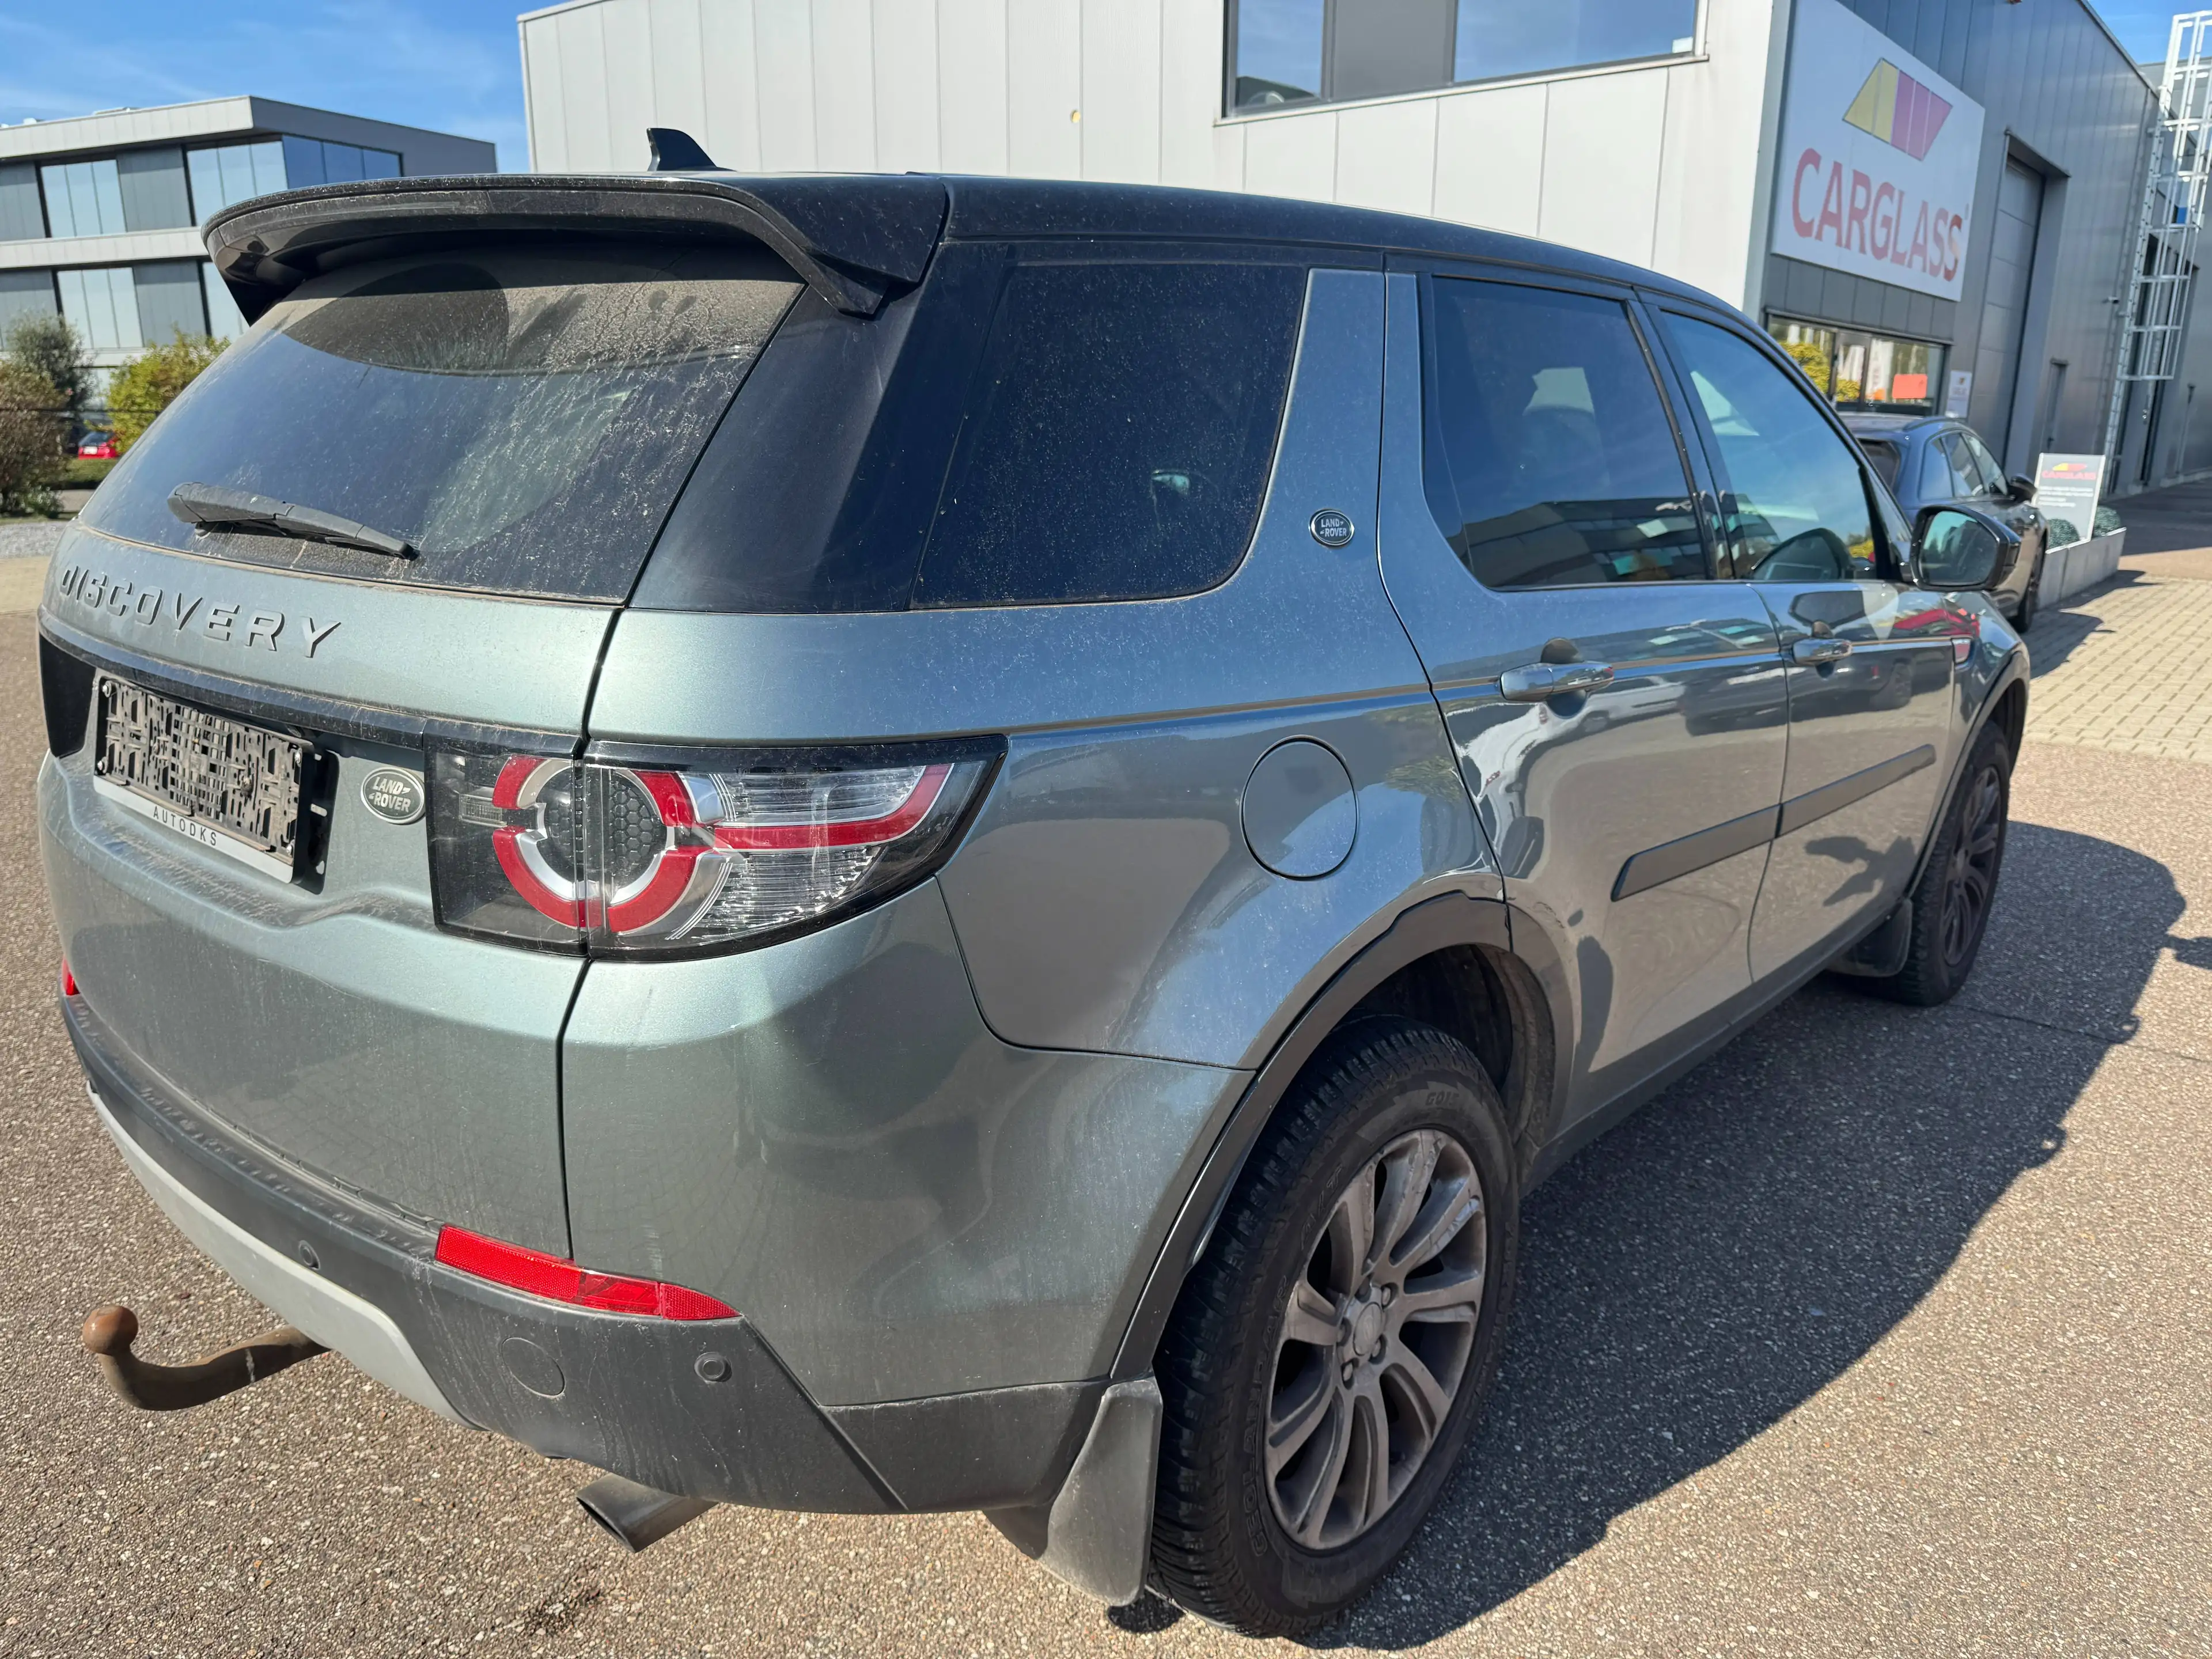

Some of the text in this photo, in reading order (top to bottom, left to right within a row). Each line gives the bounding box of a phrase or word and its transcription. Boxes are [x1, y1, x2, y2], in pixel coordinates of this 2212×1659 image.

[1792, 147, 1963, 282] CARGLASS
[1321, 518, 1340, 528] LAND
[1325, 527, 1347, 537] ROVER
[59, 566, 342, 658] DISCOVERY
[373, 777, 404, 795] LAND
[374, 791, 411, 813] ROVER
[153, 806, 217, 846] AUTODKS
